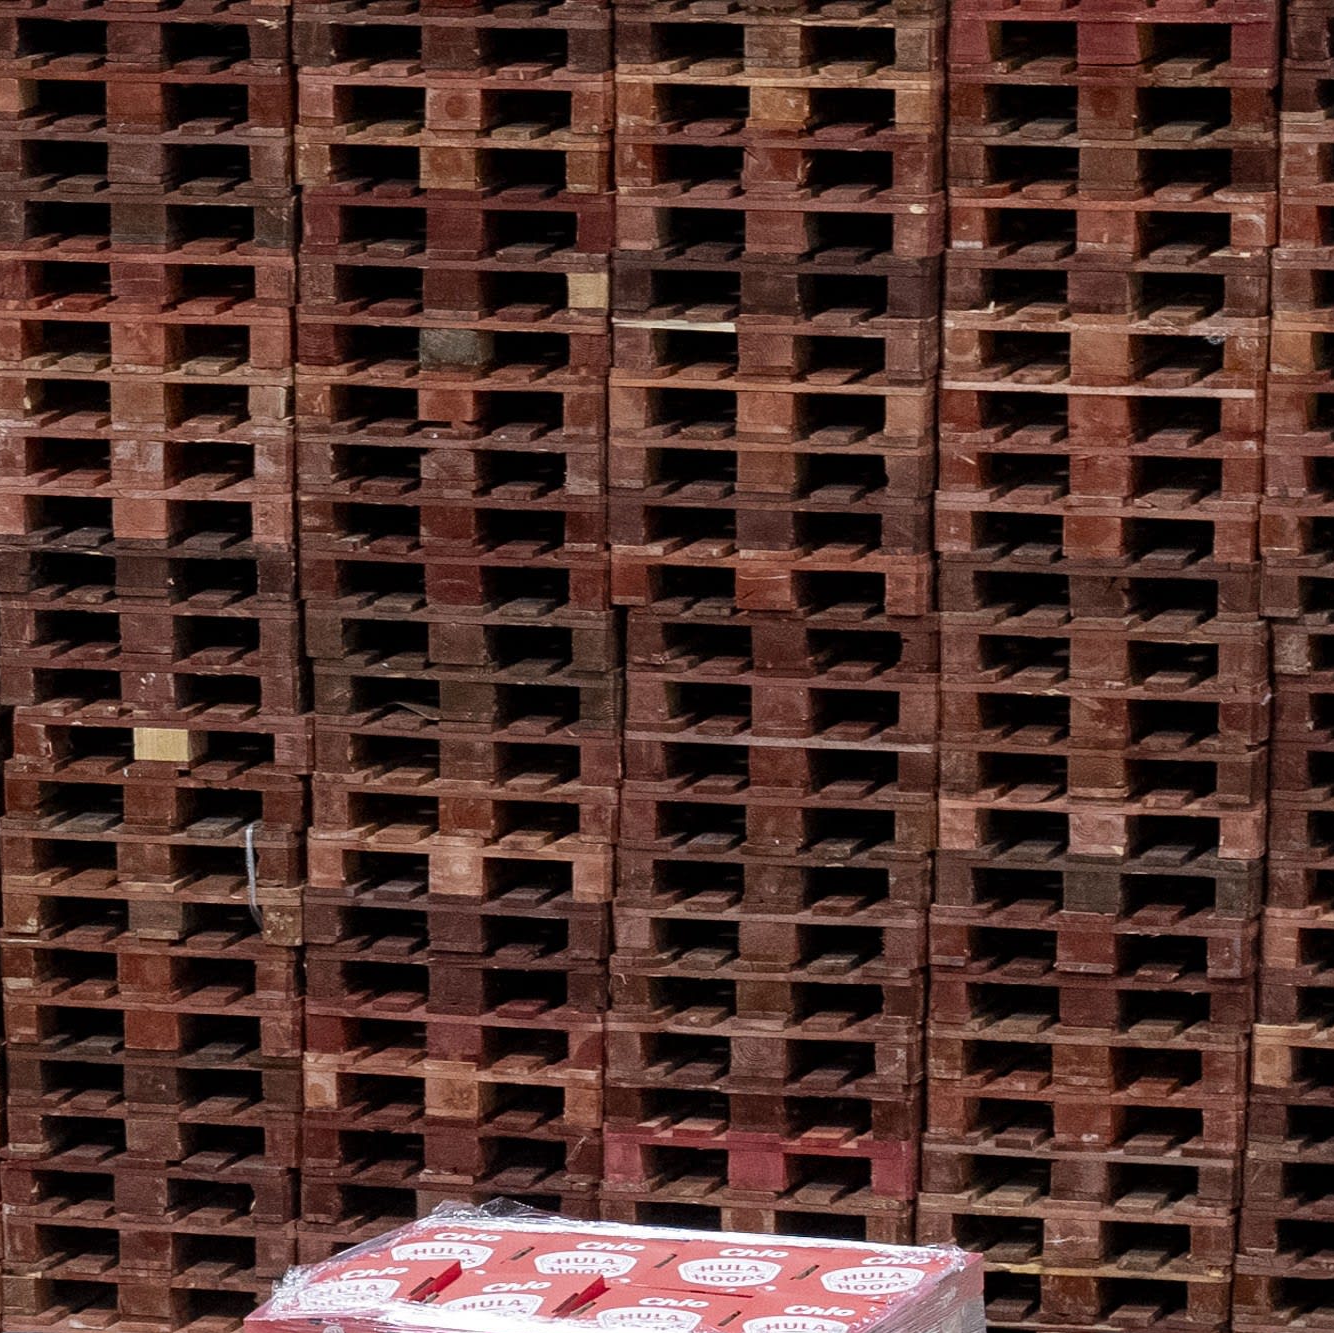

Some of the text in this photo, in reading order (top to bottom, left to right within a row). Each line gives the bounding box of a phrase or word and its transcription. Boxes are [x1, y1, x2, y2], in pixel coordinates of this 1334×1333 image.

[433, 1232, 503, 1242] Chio
[413, 1247, 470, 1256] HULA
[576, 1241, 645, 1252] Chio
[719, 1248, 789, 1259] Chio
[557, 1257, 615, 1266] HULA
[861, 1256, 931, 1266] Chio
[341, 1266, 409, 1280] Chio
[700, 1264, 759, 1272] HULA
[692, 1273, 766, 1283] HOOPS
[843, 1272, 904, 1280] HULA
[482, 1281, 551, 1292] Chio
[837, 1280, 911, 1290] HOOPS
[639, 1298, 709, 1308] Chio
[783, 1305, 855, 1316] Chio
[619, 1312, 679, 1321] HULA
[767, 1322, 826, 1332] HULA
